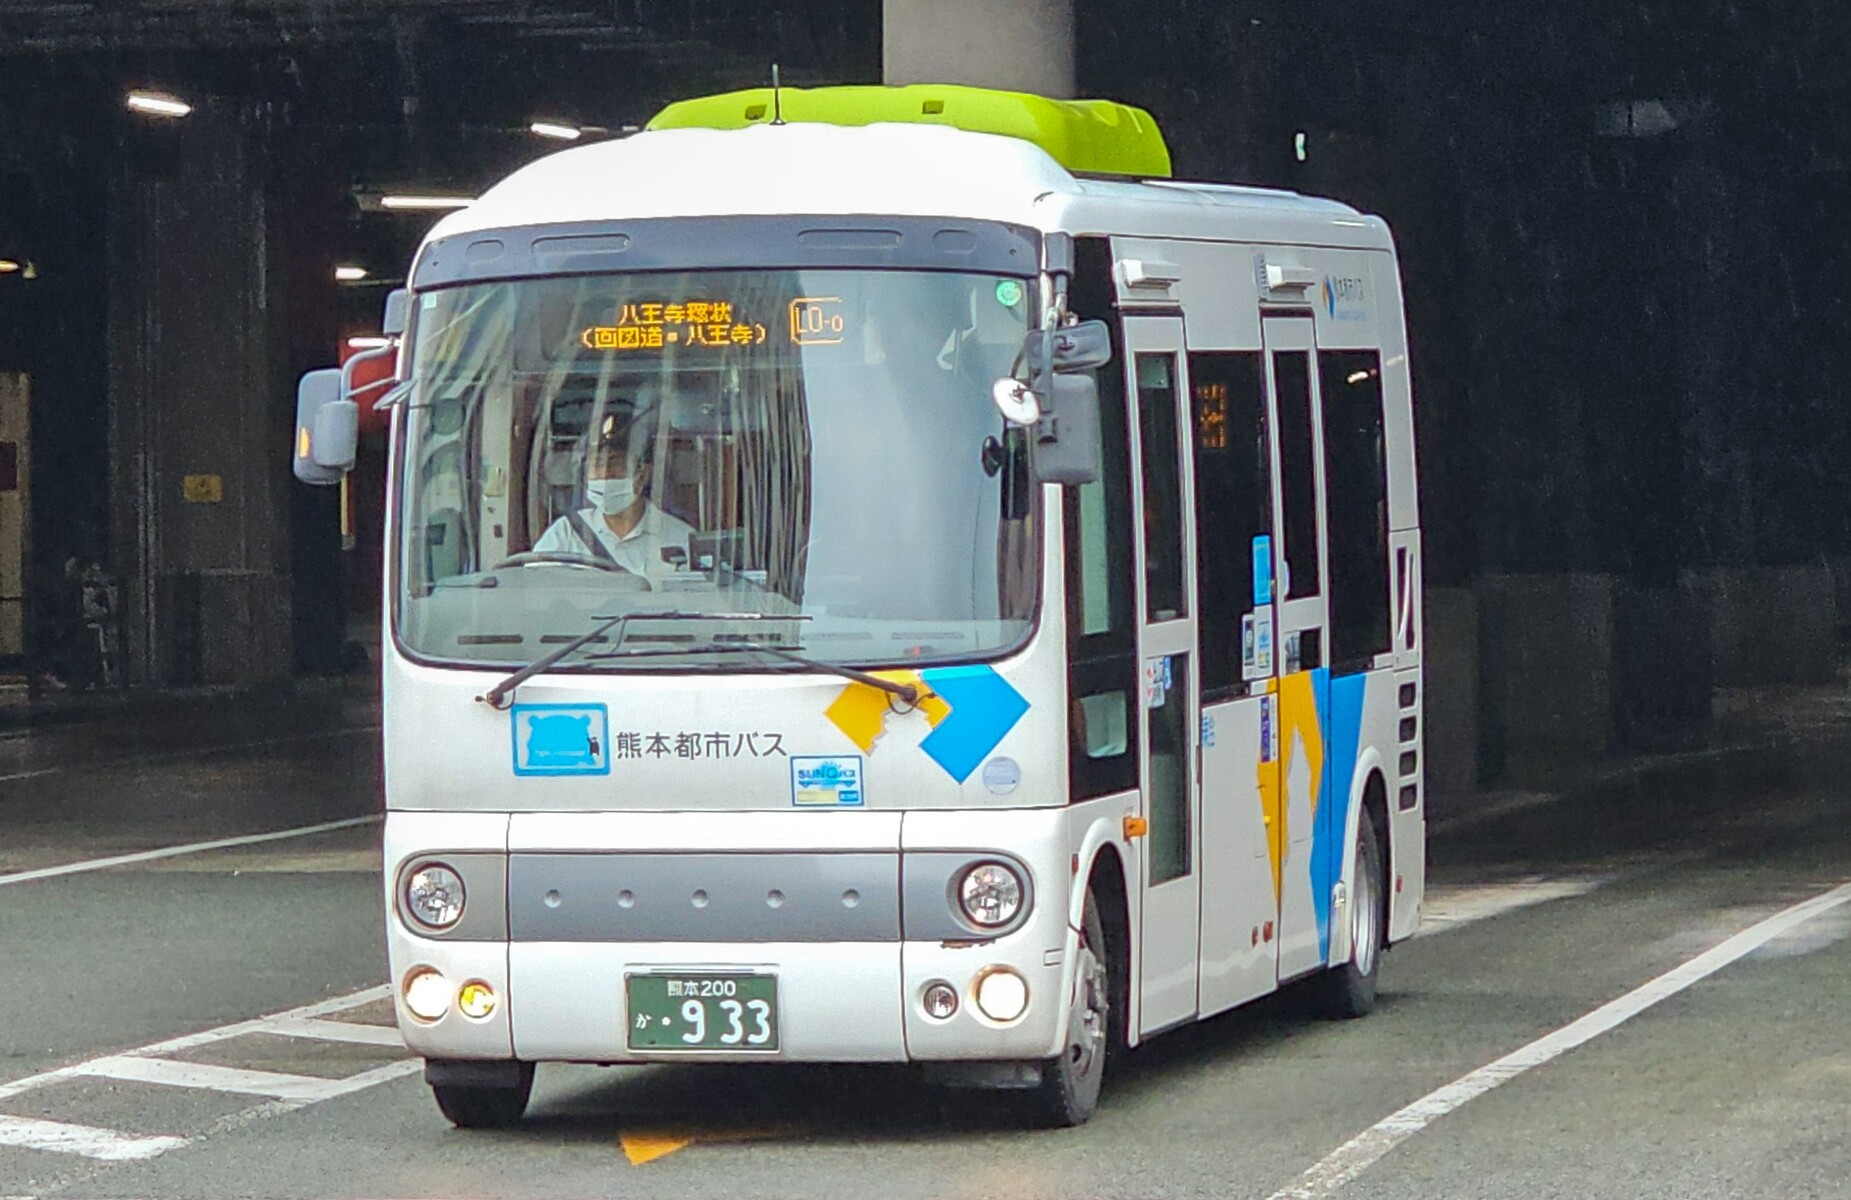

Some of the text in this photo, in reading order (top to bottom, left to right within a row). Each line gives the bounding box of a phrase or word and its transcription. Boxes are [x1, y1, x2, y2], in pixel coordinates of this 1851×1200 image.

[618, 302, 733, 325] 八王寺環状
[616, 731, 788, 760] 熊本都市バス
